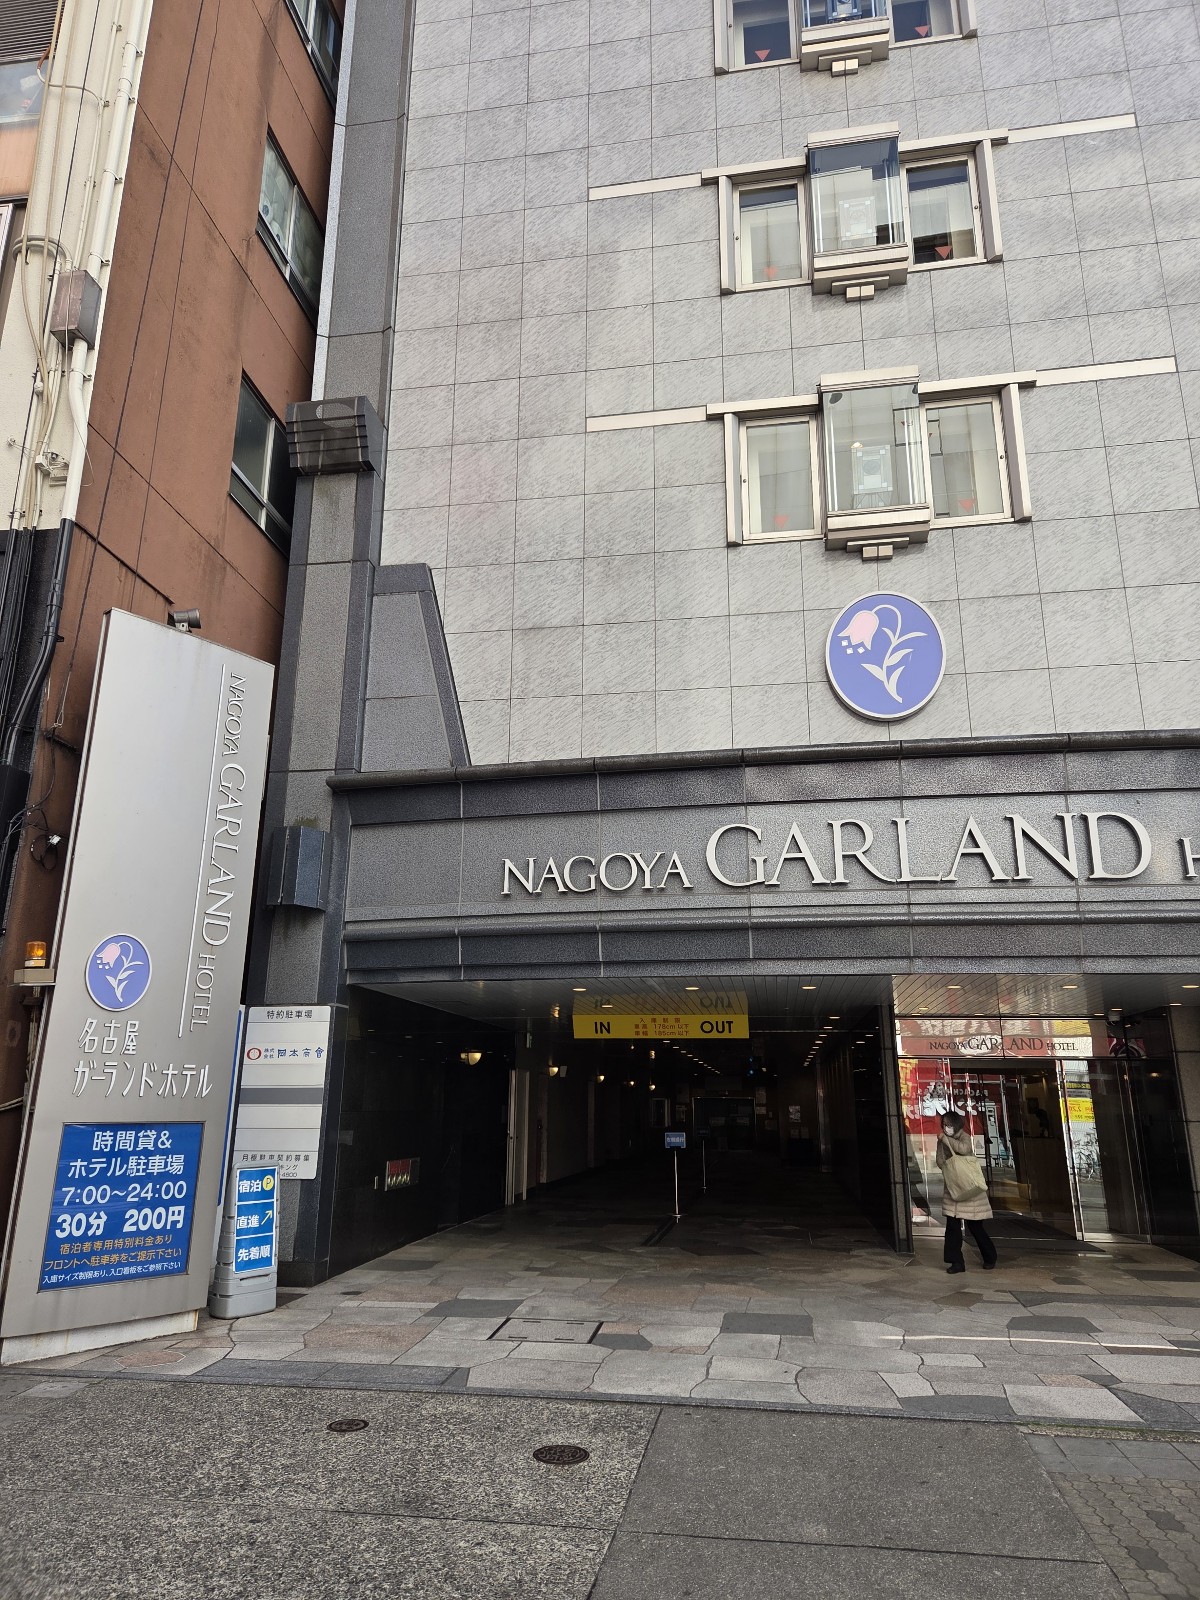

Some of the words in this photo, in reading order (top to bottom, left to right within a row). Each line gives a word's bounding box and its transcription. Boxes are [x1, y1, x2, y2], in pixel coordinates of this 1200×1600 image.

[222, 672, 246, 756] NAGOYA
[202, 763, 246, 946] GARLAND
[501, 851, 694, 895] NAGOYA
[706, 812, 1151, 887] GARLAND
[190, 953, 216, 1032] HOTEL
[266, 1010, 313, 1019] 特約駐車場
[78, 1018, 139, 1055] 名古屋
[594, 1021, 611, 1034] IN
[700, 1020, 733, 1034] OUT
[929, 1041, 966, 1051] NAGOYA
[967, 1037, 1043, 1051] GARLAND
[1047, 1041, 1078, 1051] HOTEL
[72, 1060, 213, 1098] ガーランドホテル
[92, 1130, 173, 1152] 時間貸&
[67, 1155, 185, 1178] ホテル駐車場
[238, 1180, 262, 1193] 宿泊
[55, 1211, 108, 1238] 30分
[122, 1205, 186, 1233] 200円
[236, 1214, 260, 1229] 直進
[59, 1234, 173, 1255] 宿泊者専用特別料金あり
[237, 1245, 271, 1262] 先着順
[44, 1248, 182, 1271] フロントへ駐車券をご提示下さい
[42, 1261, 181, 1284] 入庫サイズ制限あり、入口看板をご参照下さい
